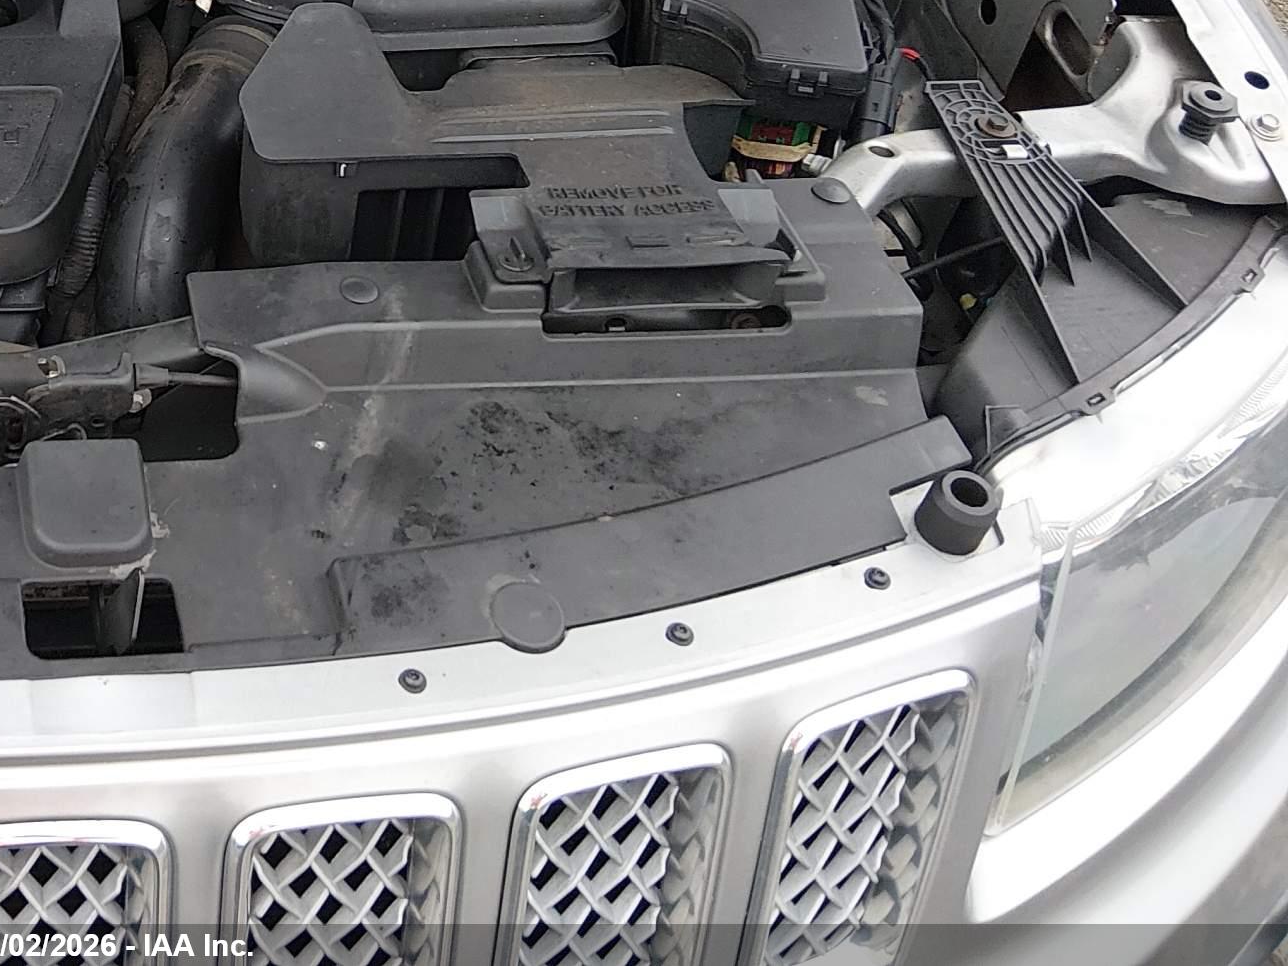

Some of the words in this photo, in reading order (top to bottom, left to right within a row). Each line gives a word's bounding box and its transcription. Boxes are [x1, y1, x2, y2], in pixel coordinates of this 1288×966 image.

[545, 186, 634, 200] REMOVE
[638, 184, 682, 198] FOR
[538, 204, 625, 217] BATTERY
[634, 200, 715, 216] ACCESS
